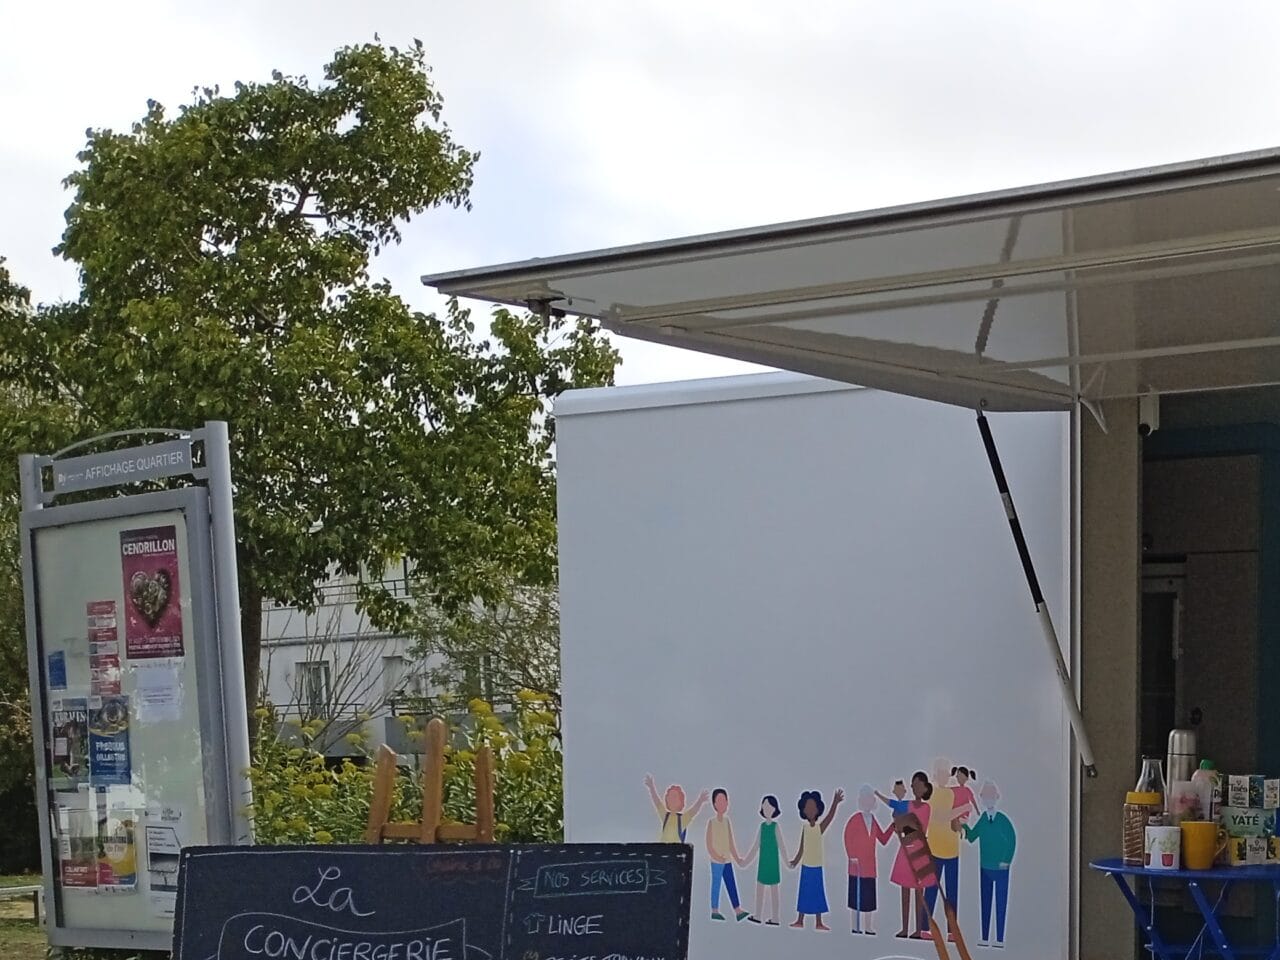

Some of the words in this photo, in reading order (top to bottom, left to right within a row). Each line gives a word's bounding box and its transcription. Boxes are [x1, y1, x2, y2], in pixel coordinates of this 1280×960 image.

[85, 459, 135, 481] AFFICHAGE
[136, 451, 183, 471] QUARTIER
[122, 539, 176, 556] CENDRILLON
[292, 866, 376, 917] La
[544, 871, 569, 889] NOS
